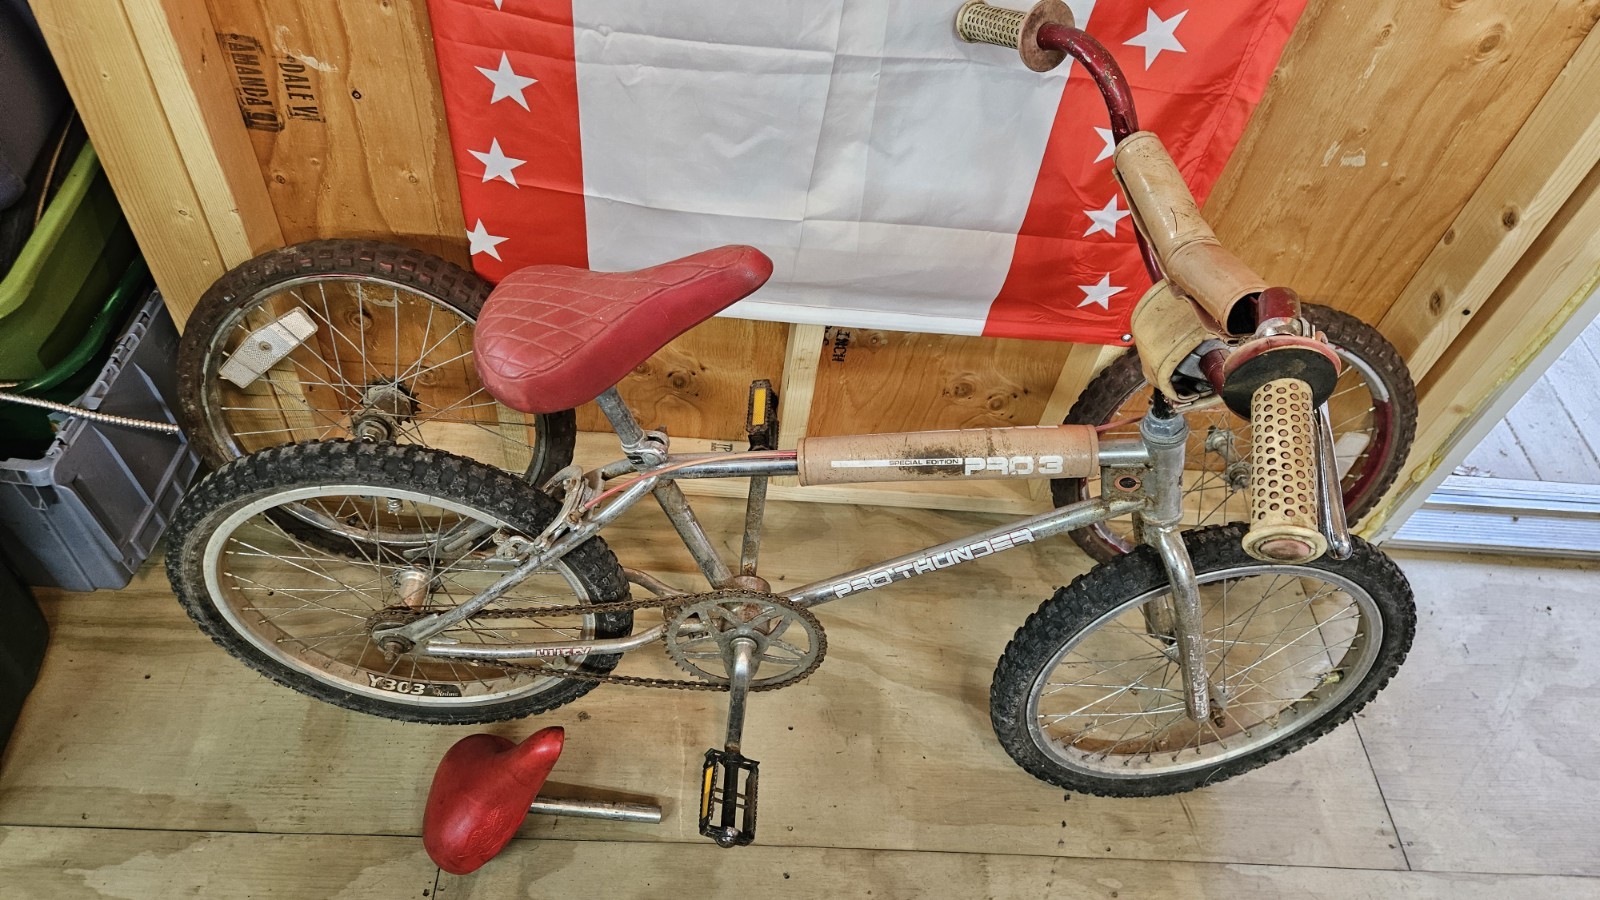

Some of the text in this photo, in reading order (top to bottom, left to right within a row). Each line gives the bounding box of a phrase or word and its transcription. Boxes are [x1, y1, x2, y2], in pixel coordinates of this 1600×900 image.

[228, 42, 273, 106] AMANDA
[279, 63, 314, 100] DALE
[832, 329, 849, 362] INCH
[1039, 455, 1064, 474] 3
[833, 528, 1036, 599] PRO THUNDER
[368, 673, 425, 695] Y303
